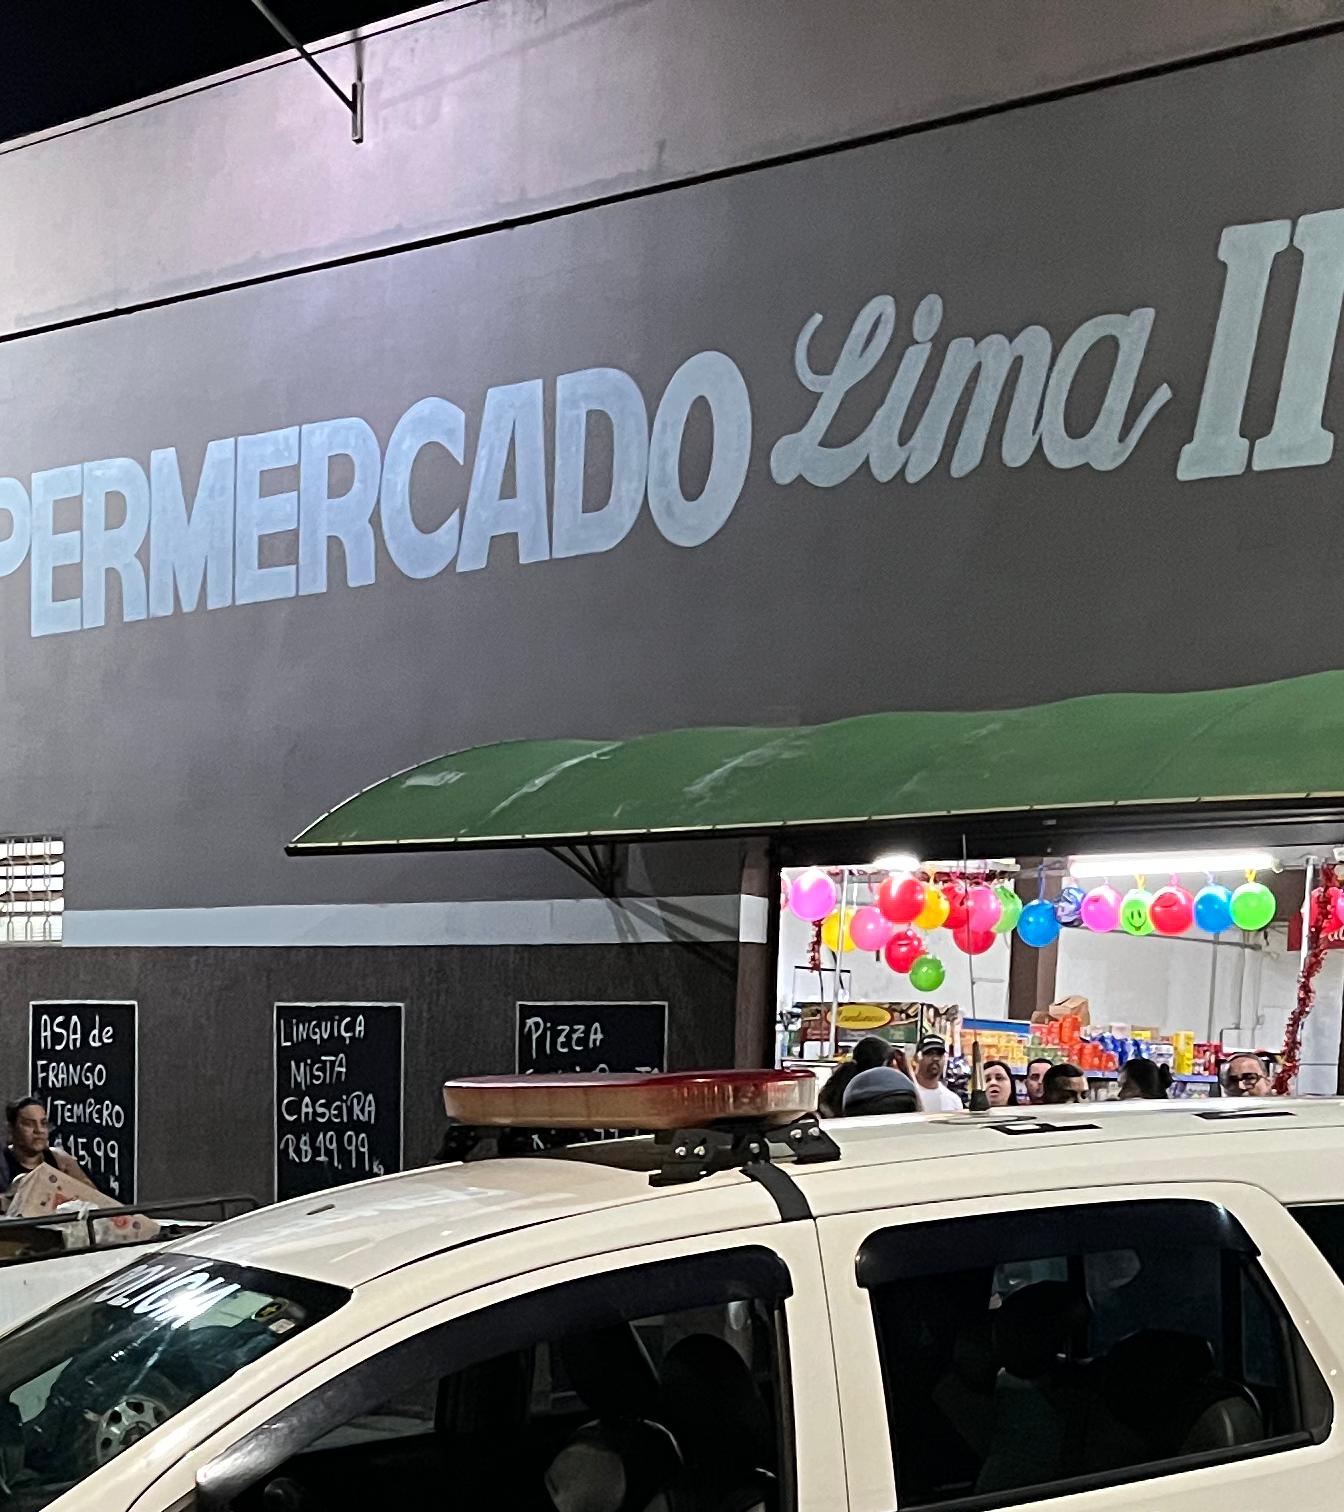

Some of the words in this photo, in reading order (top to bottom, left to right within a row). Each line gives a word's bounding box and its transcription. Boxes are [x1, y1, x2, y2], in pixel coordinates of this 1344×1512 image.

[769, 293, 1173, 488] Lima
[40, 1014, 81, 1051] ASA
[88, 1012, 114, 1048] de
[36, 1060, 106, 1090] FRANGO
